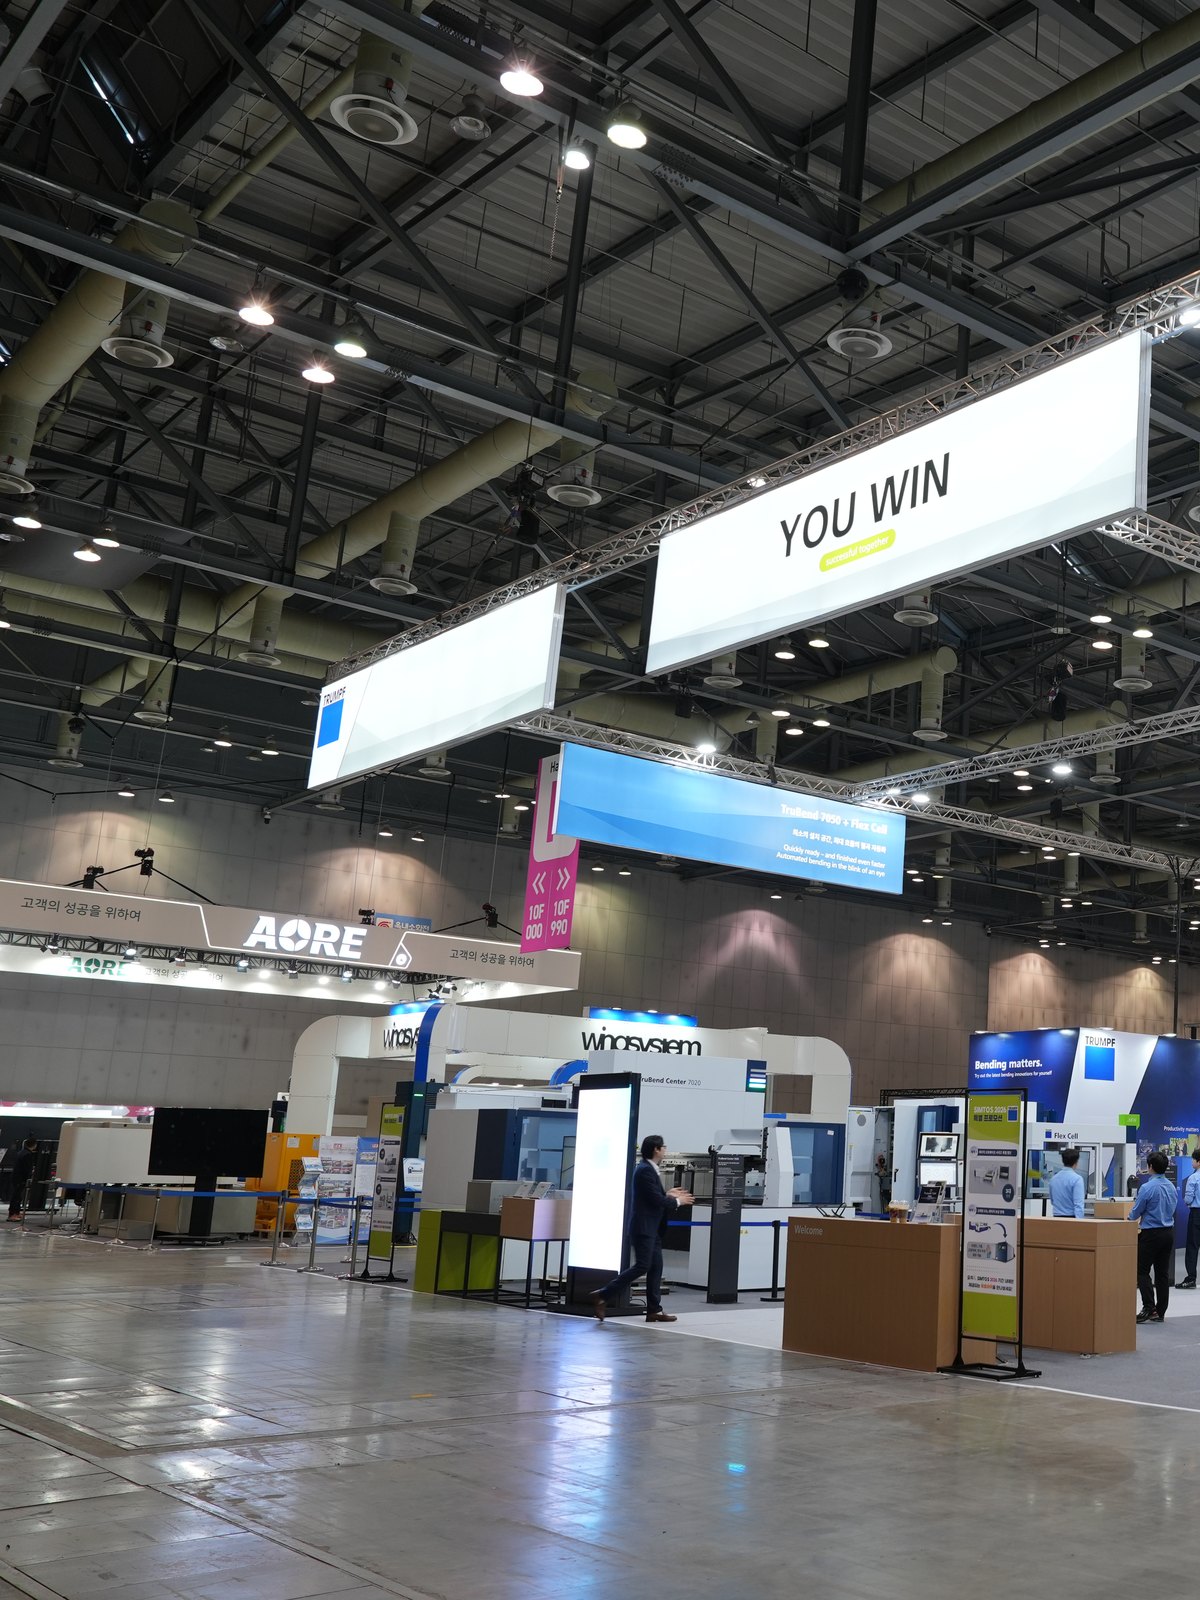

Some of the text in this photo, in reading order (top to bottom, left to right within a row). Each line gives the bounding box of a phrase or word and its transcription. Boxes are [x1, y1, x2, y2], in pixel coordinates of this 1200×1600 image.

[780, 452, 950, 557] YOU WIN
[826, 536, 889, 566] successful together
[324, 686, 346, 706] TRUMPF
[781, 804, 818, 820] TruBend
[820, 812, 840, 825] 7050
[851, 818, 869, 831] Flex
[870, 823, 888, 835] Cell
[776, 852, 807, 863] Automated
[808, 857, 831, 868] bending
[784, 844, 804, 854] Quickly
[805, 848, 820, 858] ready
[836, 853, 857, 863] finished
[871, 860, 885, 868] faster
[20, 897, 141, 922] 고객의 성공을 위하여
[529, 904, 544, 921] 10F
[553, 899, 570, 916] 10F
[526, 922, 543, 940] 000
[550, 919, 567, 936] 990
[243, 915, 368, 959] AORE
[450, 950, 535, 968] 고객의 성공을 위하여
[1085, 1036, 1116, 1047] TRUMPF
[975, 1059, 1042, 1071] Bending matters.
[794, 1225, 823, 1236] Welcome
